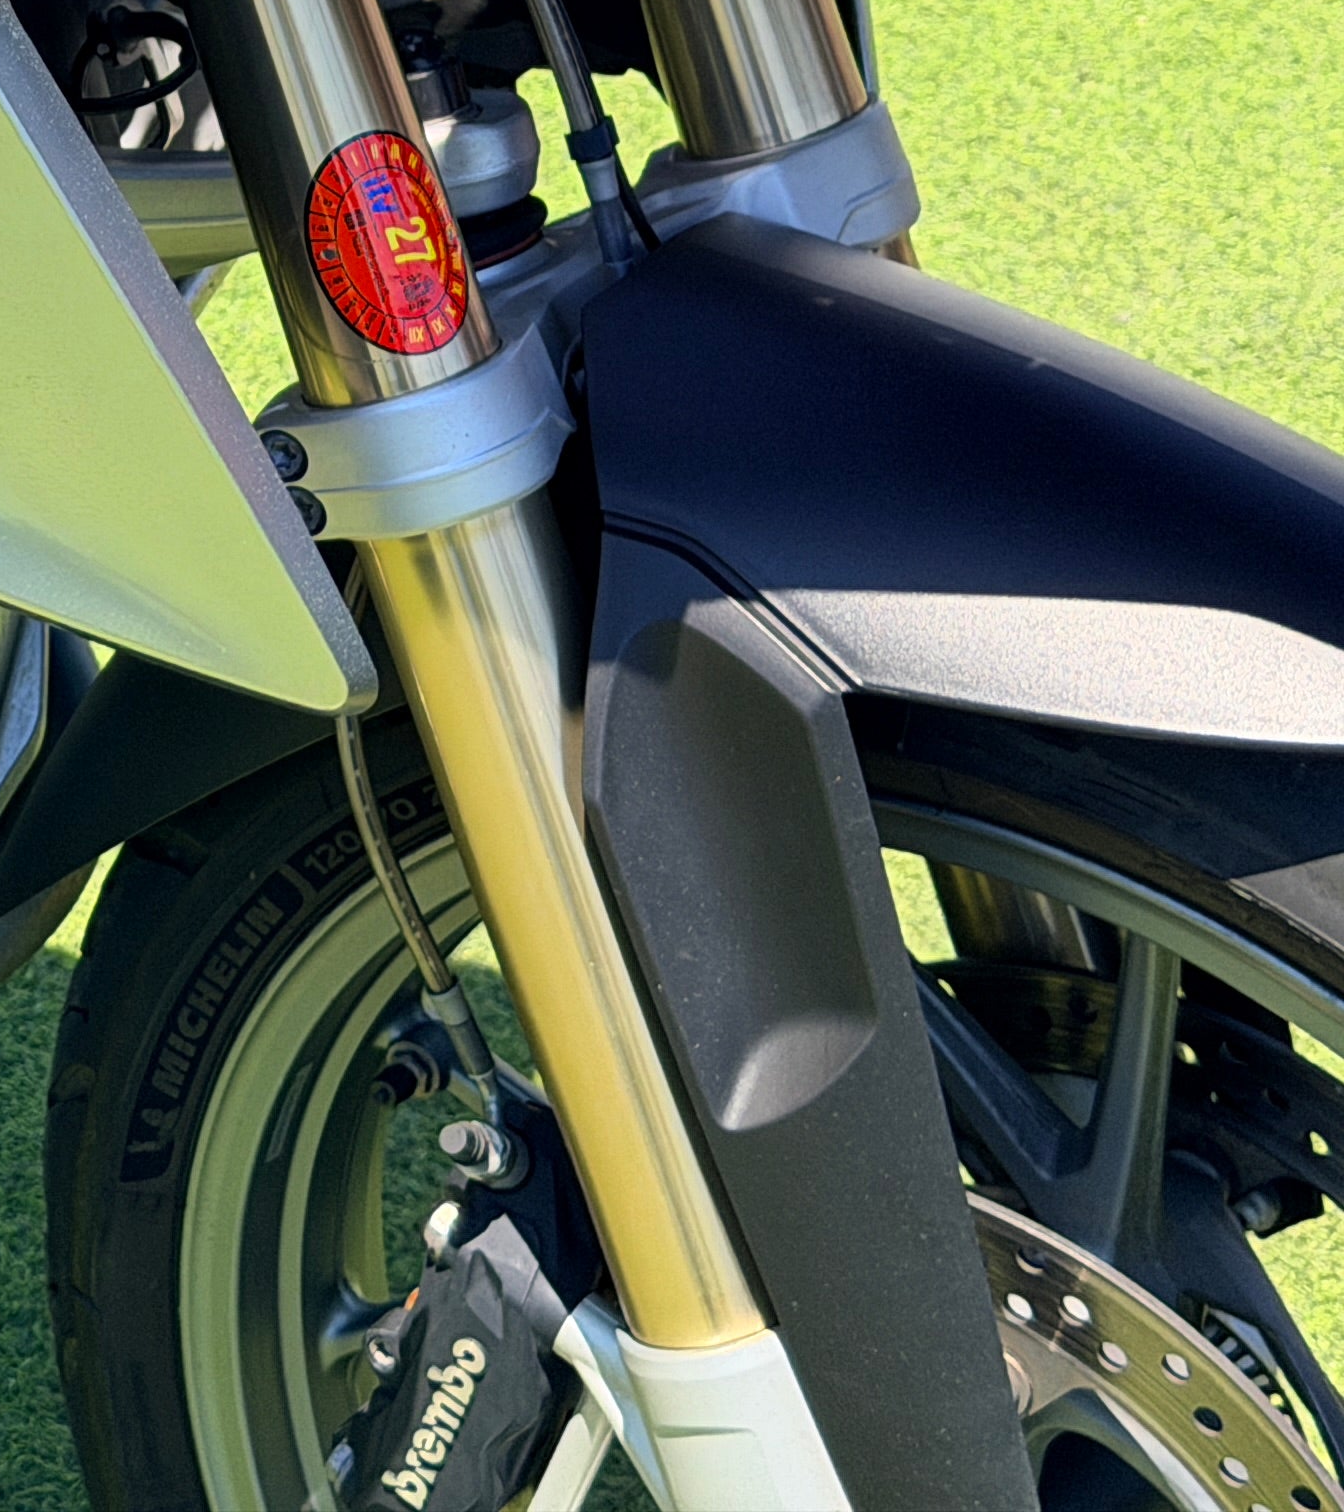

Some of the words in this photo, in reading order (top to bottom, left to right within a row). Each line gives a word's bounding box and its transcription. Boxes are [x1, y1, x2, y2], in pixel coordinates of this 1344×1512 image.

[385, 216, 437, 265] 27
[152, 895, 285, 1094] MICHELIN
[380, 1337, 487, 1511] brembo
